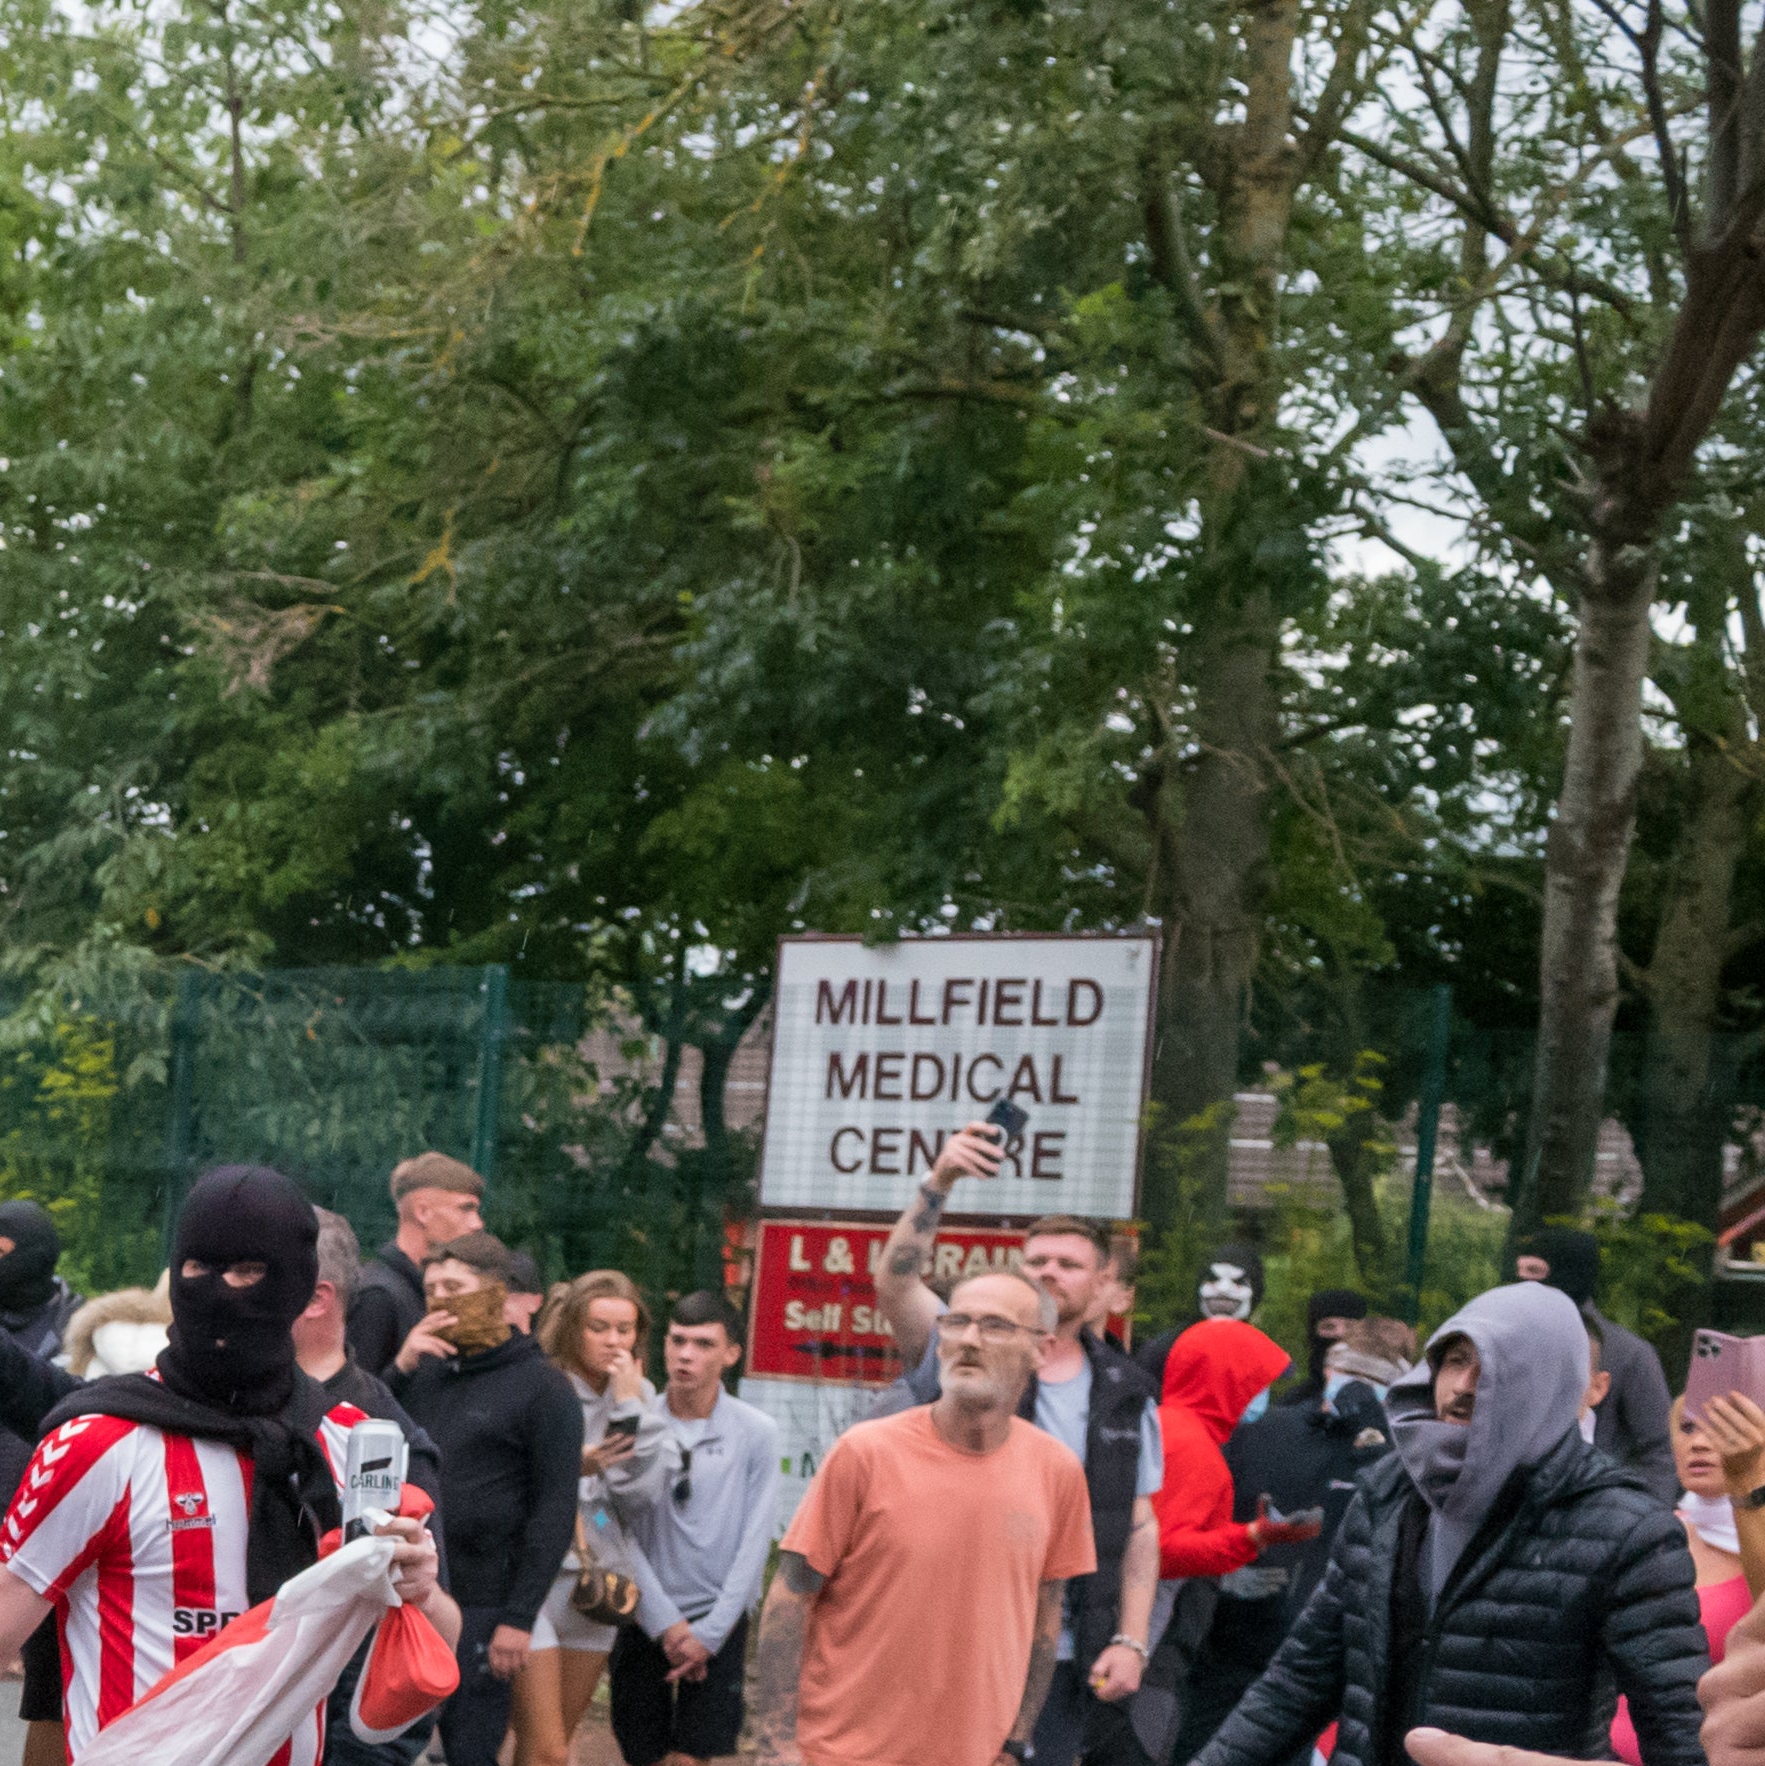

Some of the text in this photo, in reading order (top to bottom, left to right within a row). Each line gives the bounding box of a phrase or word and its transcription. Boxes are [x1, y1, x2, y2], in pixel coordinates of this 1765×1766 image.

[815, 978, 1105, 1027] MILLFIELD
[826, 1053, 1080, 1103] MEDICAL
[830, 1127, 1067, 1179] CENRE
[789, 1234, 812, 1272] L
[823, 1237, 855, 1274] &
[785, 1300, 842, 1333] Self
